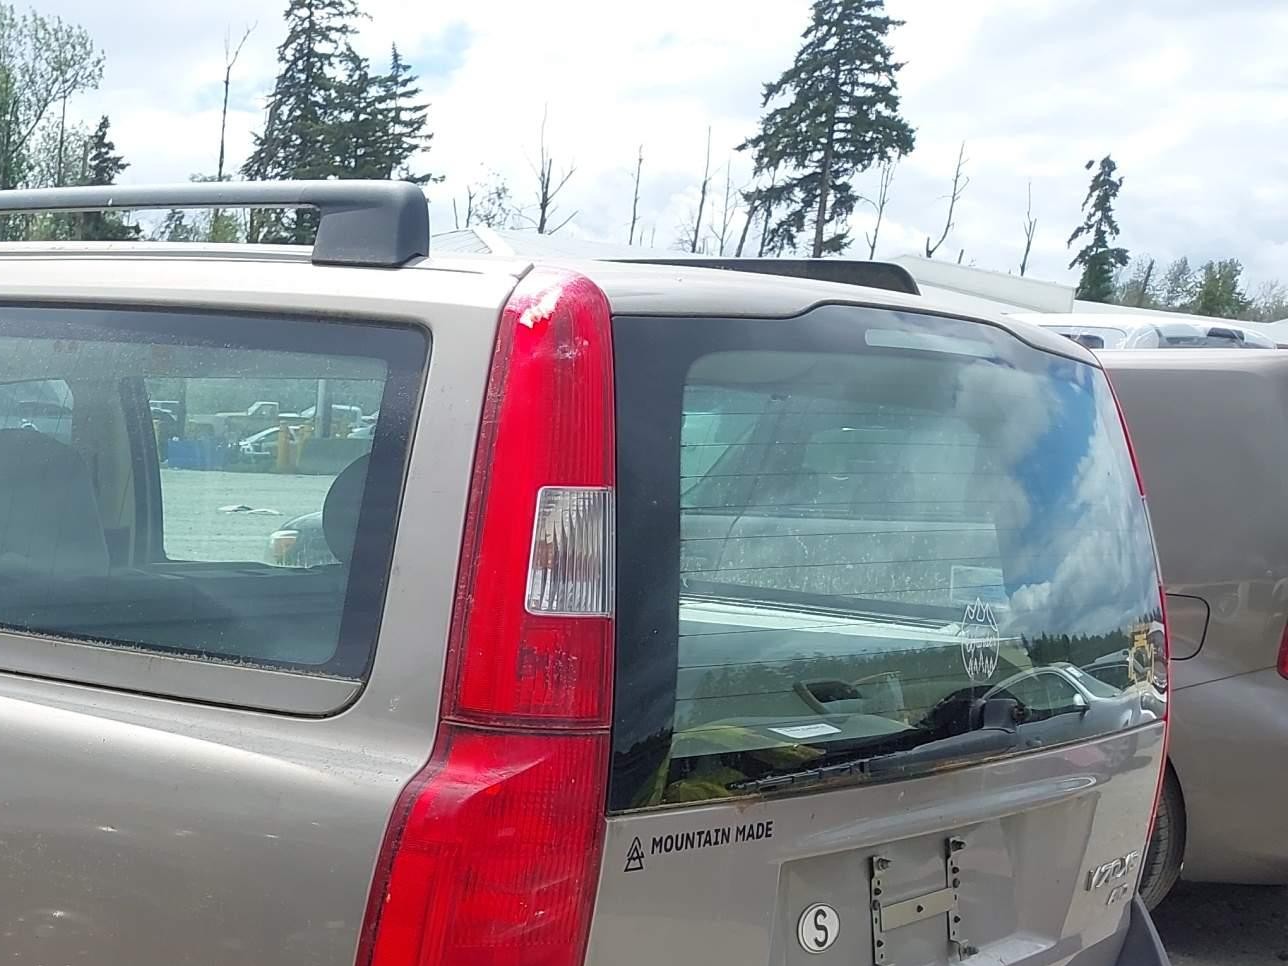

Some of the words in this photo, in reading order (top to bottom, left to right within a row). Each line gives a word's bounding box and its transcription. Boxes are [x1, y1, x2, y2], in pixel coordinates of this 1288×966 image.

[650, 827, 731, 854] MOUNTAIN
[735, 821, 773, 842] MADE
[813, 909, 829, 947] S
